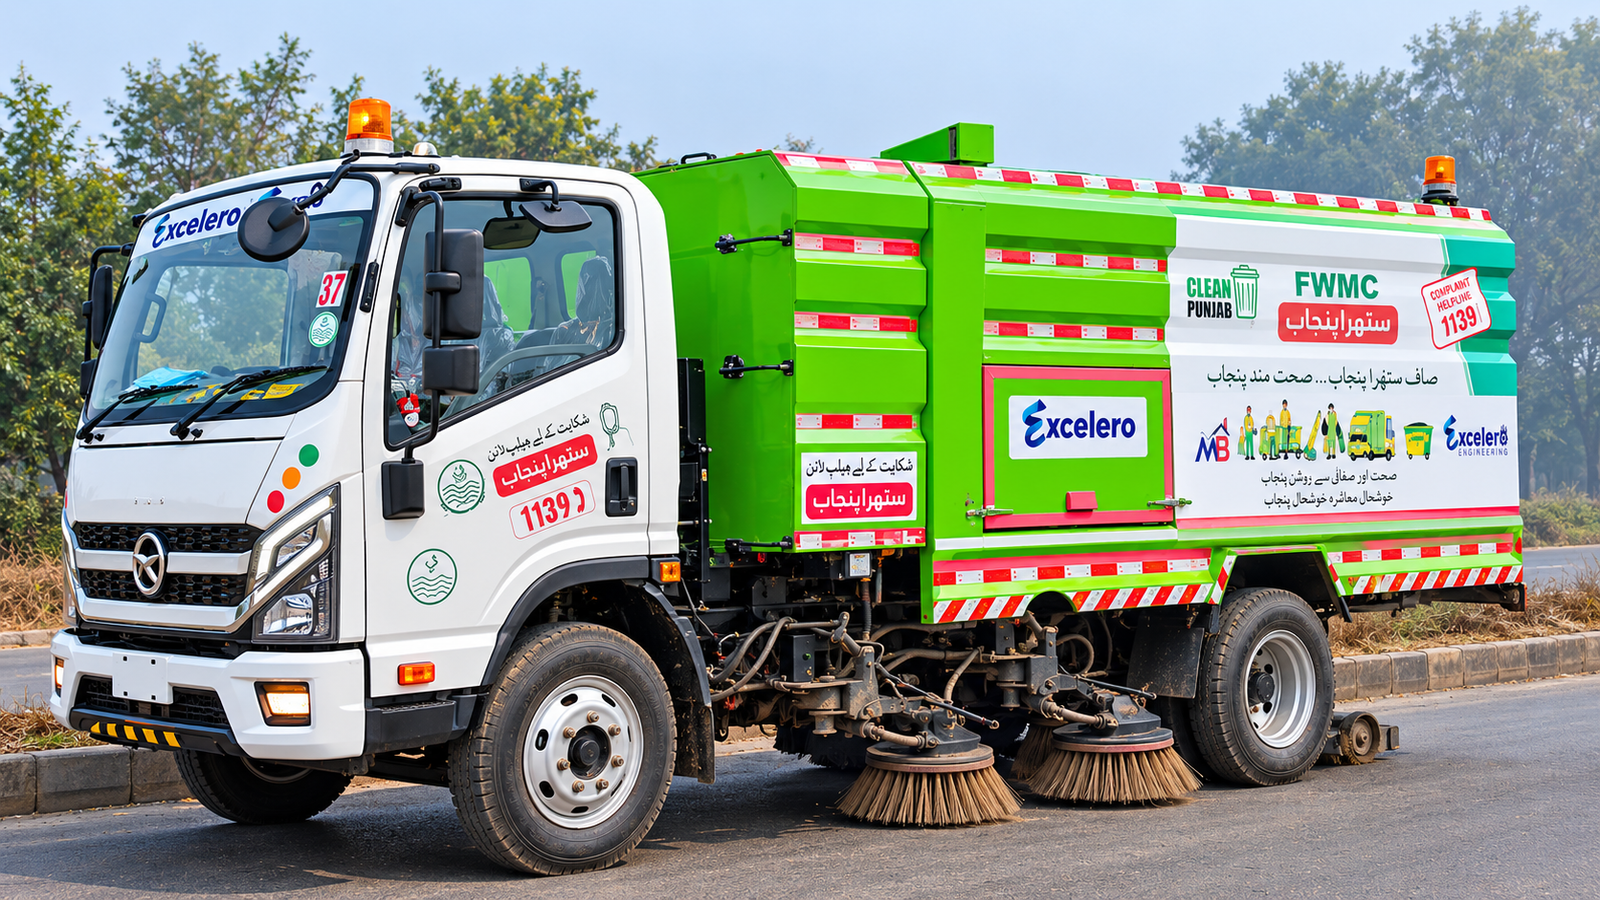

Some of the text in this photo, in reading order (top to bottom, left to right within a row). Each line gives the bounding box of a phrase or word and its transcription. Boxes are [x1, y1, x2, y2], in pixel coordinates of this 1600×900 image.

[152, 206, 241, 248] Excelero
[318, 273, 346, 306] 37
[1186, 276, 1231, 299] CLEAN
[1295, 271, 1379, 299] FWMC
[1187, 300, 1232, 318] PUNJAB
[1441, 305, 1477, 337] 1139
[1207, 364, 1247, 391] پنجاب
[1250, 369, 1270, 382] مند
[1273, 370, 1312, 383] صحت
[1405, 367, 1438, 385] صاف
[545, 423, 556, 439] کے
[557, 413, 590, 434] شکایت
[1022, 399, 1136, 448] Excelero
[1443, 414, 1508, 451] Excelero
[1195, 435, 1230, 462] MB
[1458, 447, 1508, 457] ENGINEERING
[866, 457, 877, 472] کے
[879, 457, 914, 475] شکایت
[1261, 471, 1288, 487] پنجاب
[1314, 475, 1330, 486] سے
[1357, 469, 1369, 485] اور
[1370, 471, 1397, 482] صحت
[1264, 493, 1291, 510] پنجاب
[1292, 492, 1327, 507] خوشحال
[1359, 490, 1393, 506] خوشحال
[520, 492, 570, 532] 1139
